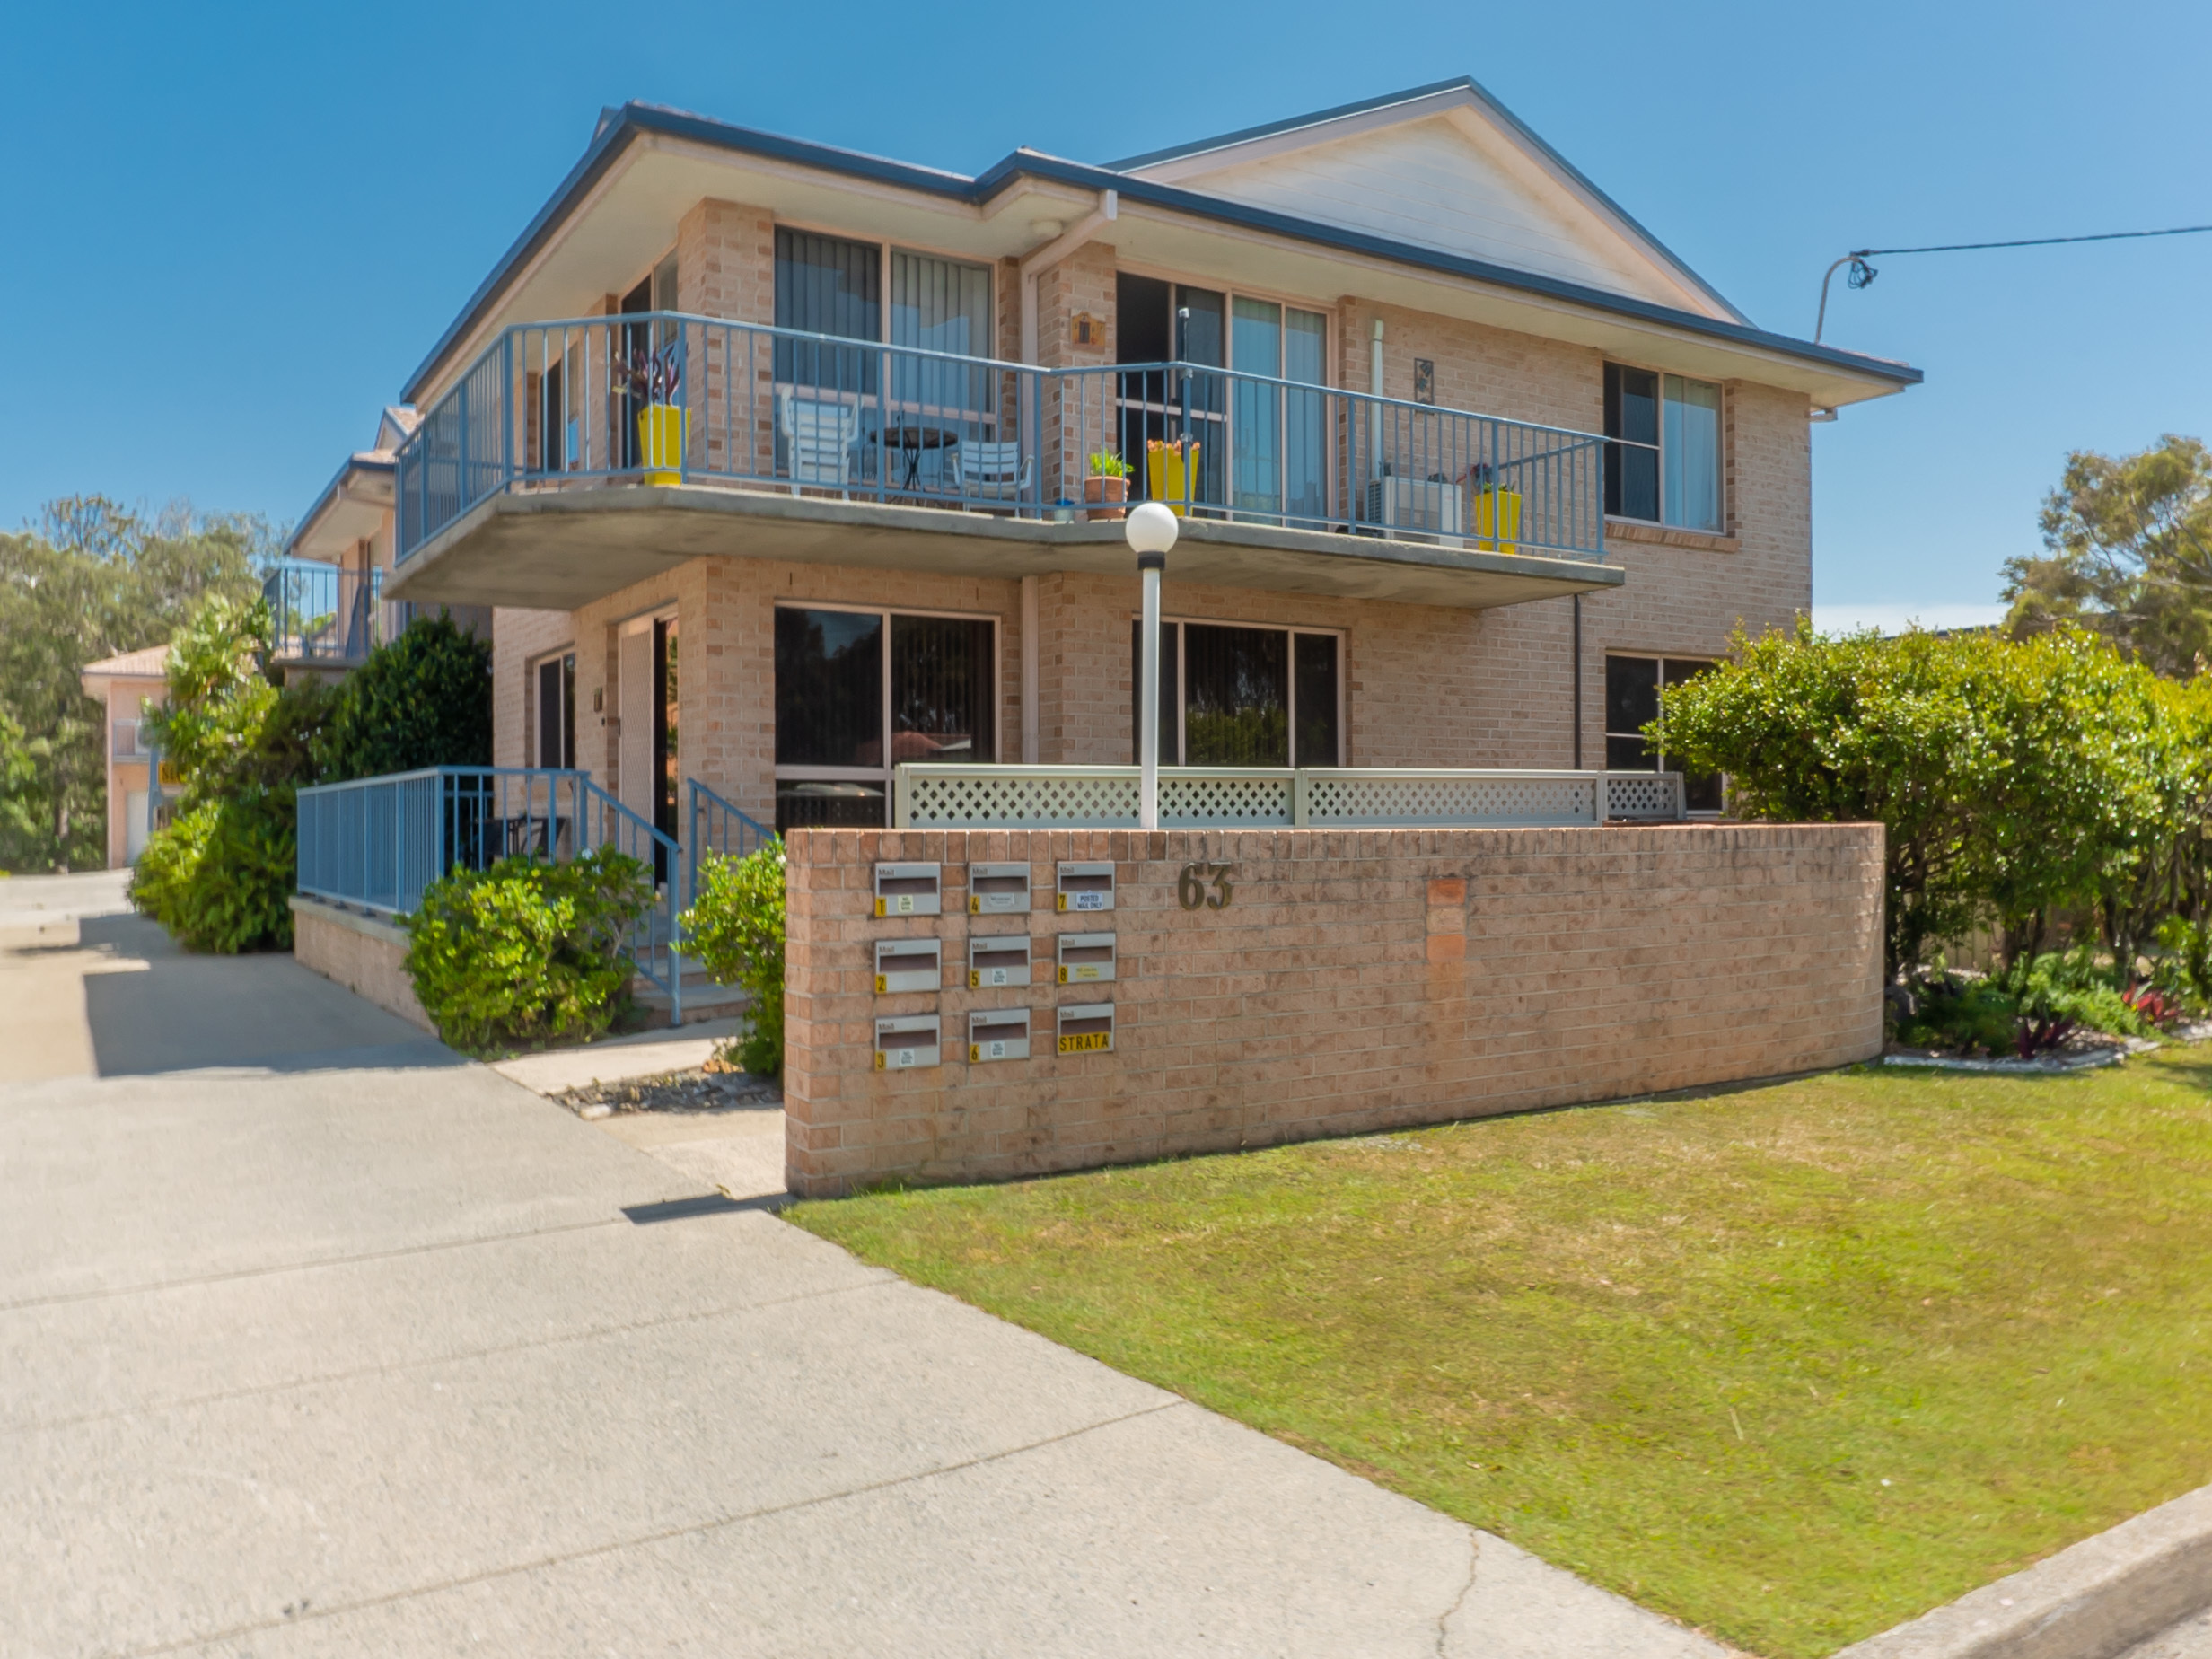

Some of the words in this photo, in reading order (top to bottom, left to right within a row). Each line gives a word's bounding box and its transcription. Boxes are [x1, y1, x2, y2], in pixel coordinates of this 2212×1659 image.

[1178, 862, 1233, 910] 63
[879, 899, 884, 914] 1
[971, 897, 978, 911] 4
[1059, 894, 1066, 908] 7
[1080, 895, 1099, 903] POSTED
[971, 971, 978, 986] 5
[1060, 967, 1066, 981] 8
[878, 977, 884, 992] 2
[1059, 1034, 1109, 1051] STRATA
[877, 1053, 884, 1068] 3
[971, 1046, 978, 1060] 6
